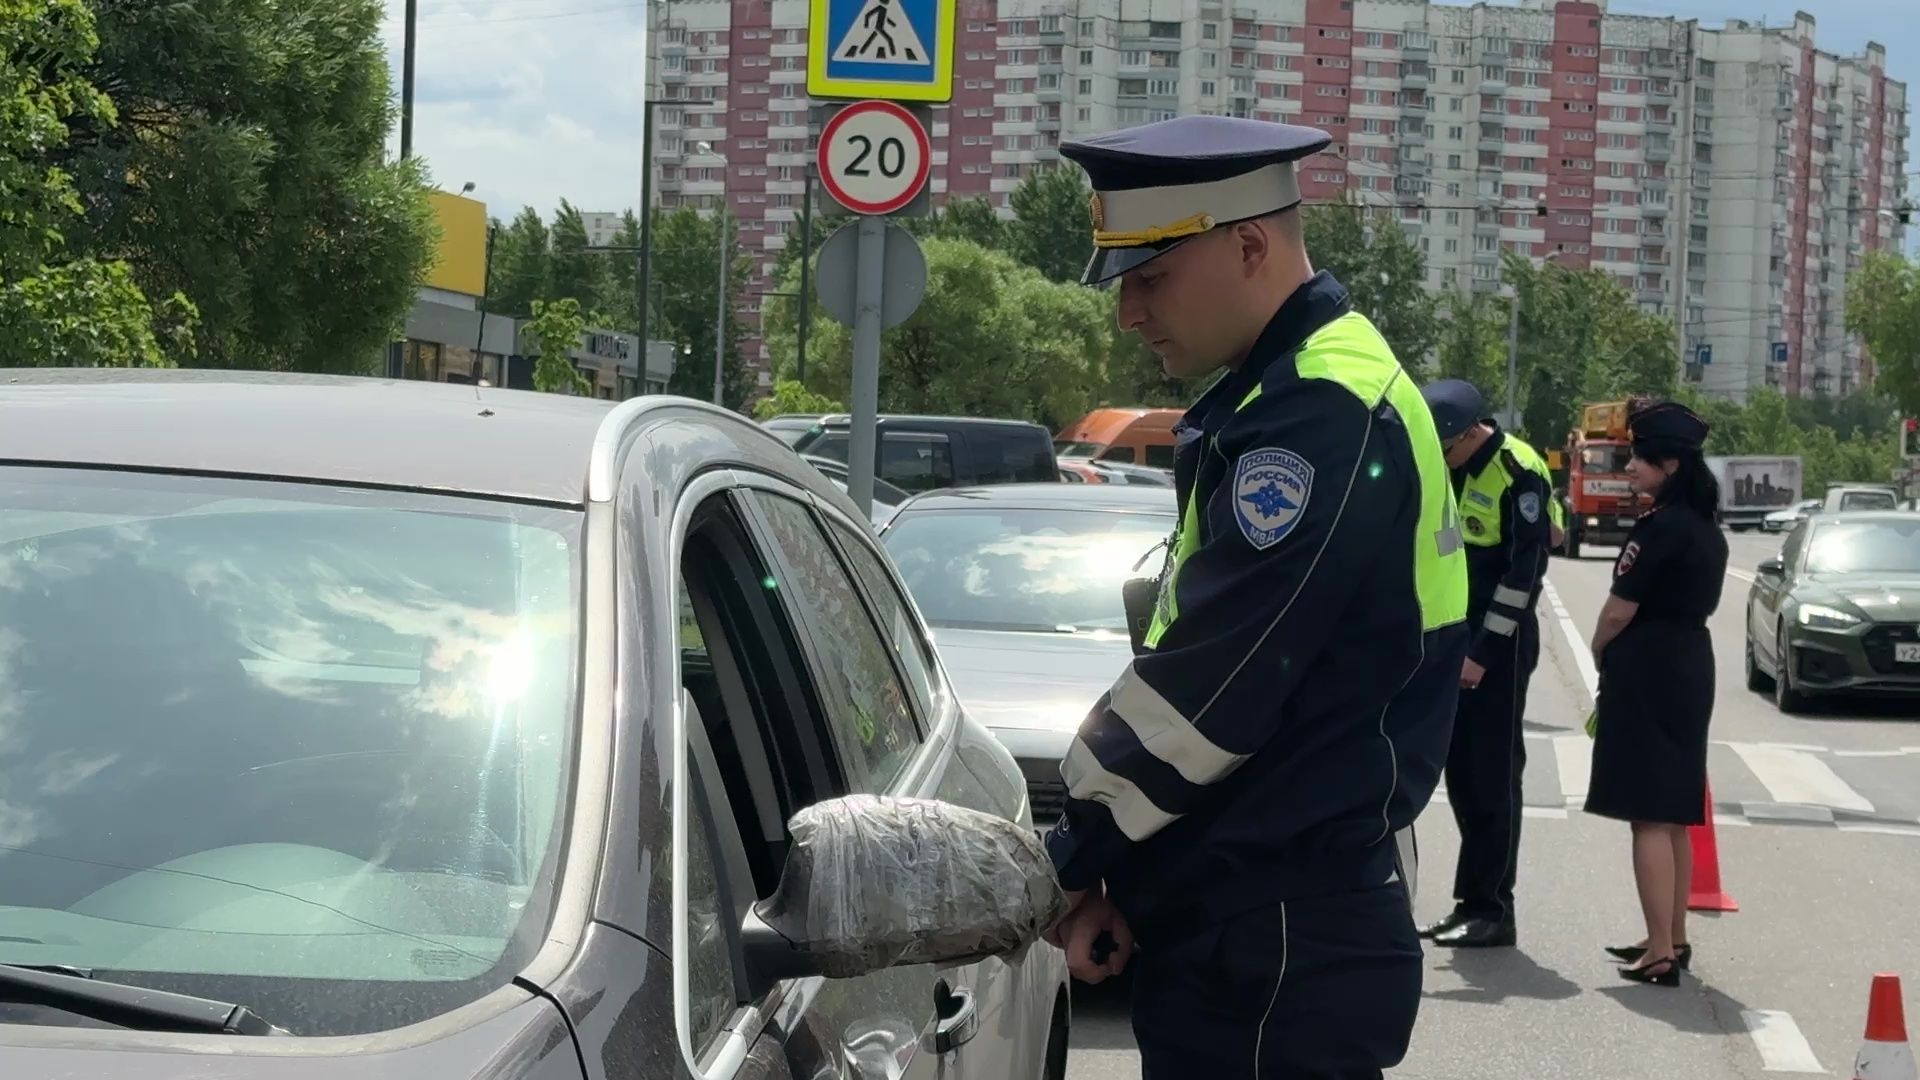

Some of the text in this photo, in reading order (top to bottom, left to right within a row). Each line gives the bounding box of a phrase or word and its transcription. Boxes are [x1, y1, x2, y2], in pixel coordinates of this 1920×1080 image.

[844, 135, 905, 178] 20
[1243, 453, 1307, 480] ПОЛИЦИЯ
[1245, 471, 1301, 494] РОССИЯ
[1249, 526, 1276, 544] МВД
[1900, 647, 1920, 660] У2
